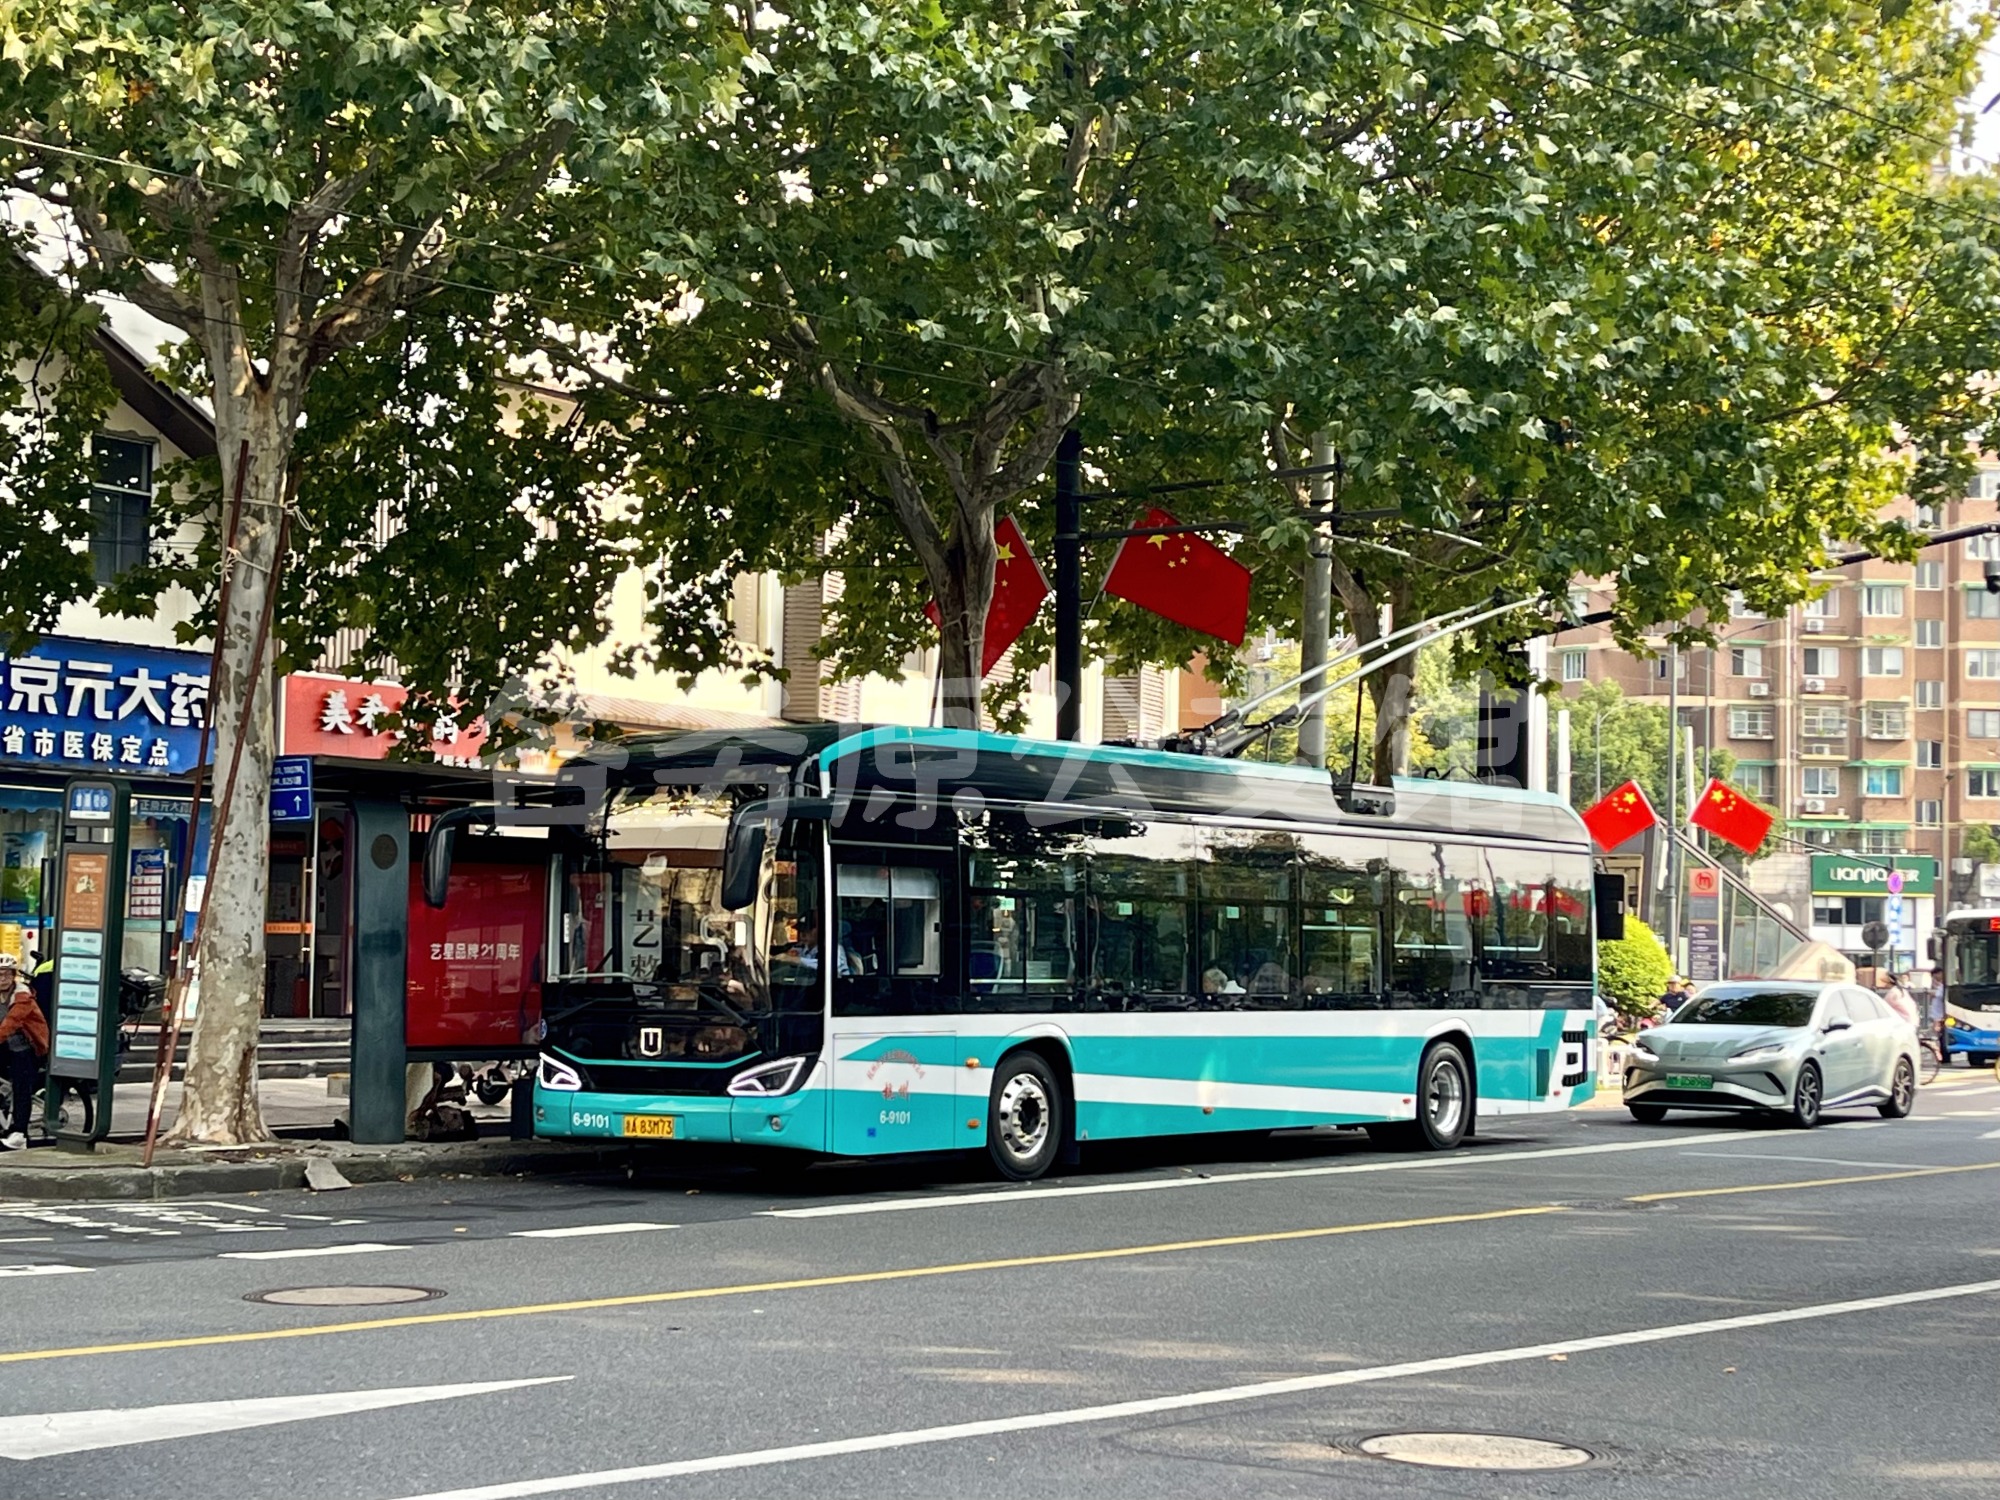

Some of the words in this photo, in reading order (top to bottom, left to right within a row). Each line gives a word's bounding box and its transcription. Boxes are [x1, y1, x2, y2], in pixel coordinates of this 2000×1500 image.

[0, 652, 215, 729] 京元大药
[3, 724, 170, 766] 省市医保定点
[430, 942, 521, 960] 艺星品牌21周年
[572, 1112, 609, 1128] 6-9101
[879, 1110, 911, 1124] 6-9101
